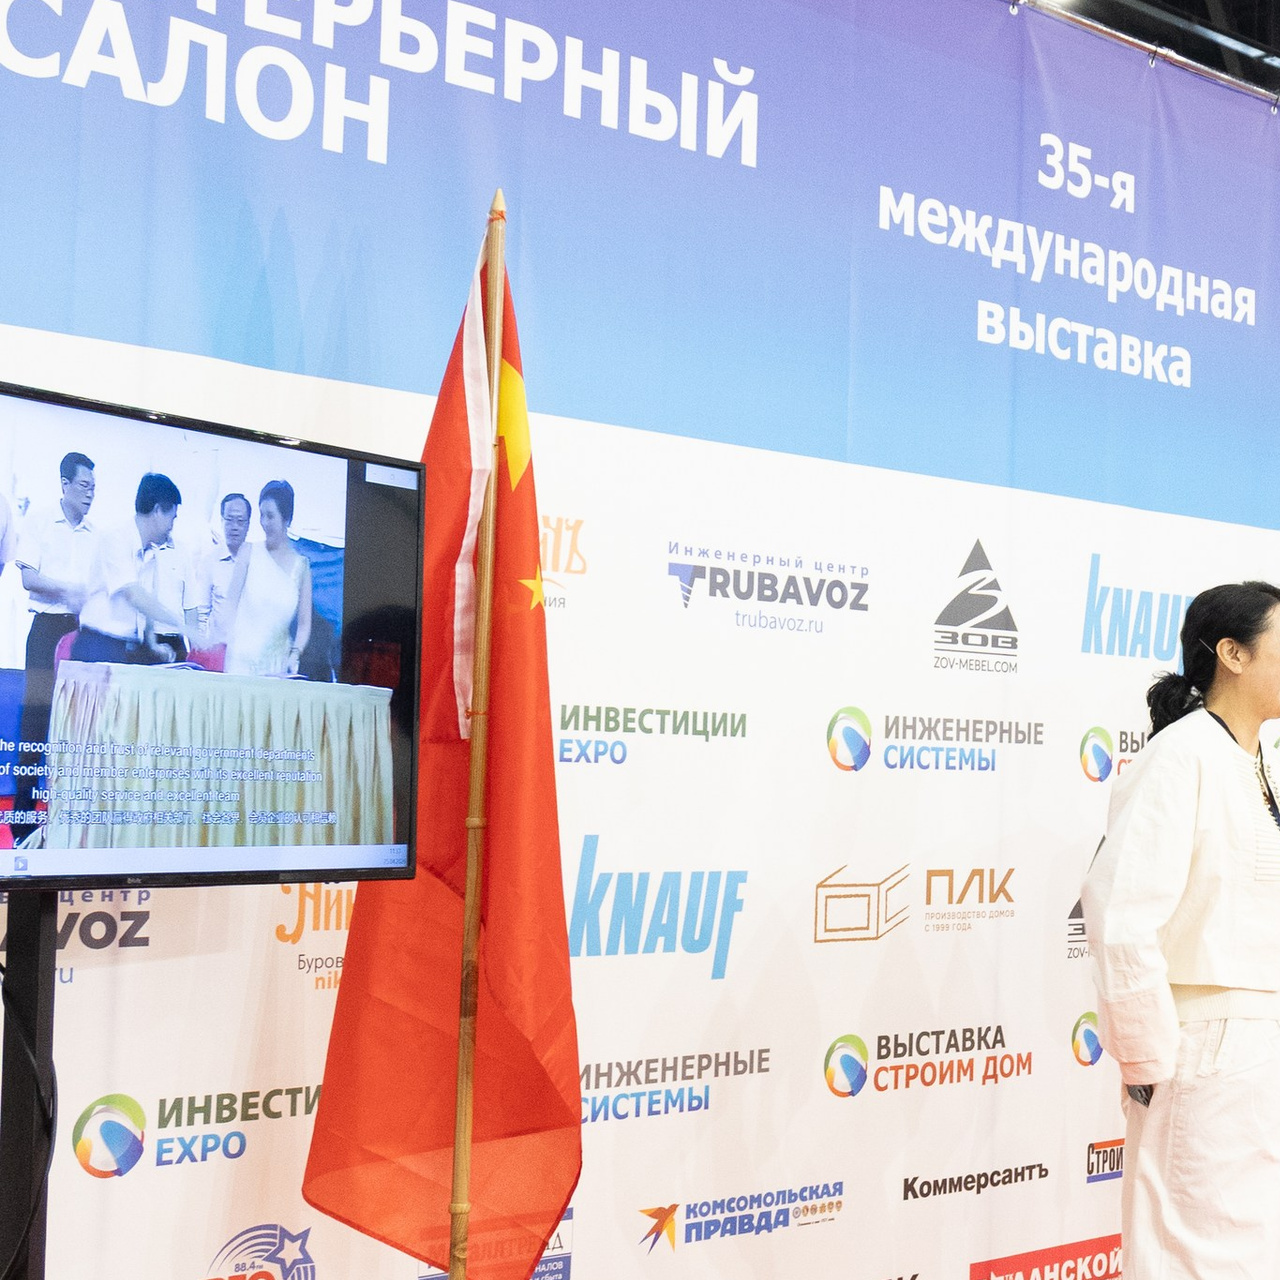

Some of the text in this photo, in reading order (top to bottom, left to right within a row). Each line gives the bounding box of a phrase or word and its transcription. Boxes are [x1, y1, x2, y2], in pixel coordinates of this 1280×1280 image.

[1037, 133, 1136, 213] 35-я
[879, 185, 1256, 326] международная
[977, 299, 1191, 388] выставка
[668, 541, 869, 578] Инженерный центр
[668, 562, 869, 611] TRUBAVOZ
[735, 610, 824, 634] trubavoz.ru
[934, 630, 1018, 650] ЗОВ
[933, 656, 1018, 673] ZOV-MEBEL.COM
[560, 704, 747, 742] ИНВЕСТИЦИИ
[884, 715, 1044, 745] ИНЖЕНЕРНЫЕ
[0, 739, 315, 761] he recognition and trust of relevant government departments
[559, 738, 627, 764] EXPO
[884, 744, 996, 772] СИСТЕМЫ
[13, 763, 55, 779] society
[58, 765, 82, 778] and
[83, 766, 129, 778] member
[132, 767, 190, 781] enterprises
[231, 769, 274, 781] excellent
[276, 771, 322, 784] reputation
[32, 787, 240, 802] high-quality service and excellent team
[60, 889, 150, 906] центр
[926, 868, 1015, 905] ПЛК
[925, 910, 1015, 921] ПРОИЗВОДСТВО ДОМОВ
[932, 924, 949, 932] 1999
[952, 923, 972, 931] ГОДА
[297, 954, 344, 974] Буров
[877, 1025, 1006, 1061] ВЫСТАВКА
[873, 1052, 1032, 1092] СТРОИМ ДОМ
[156, 1131, 247, 1167] EXPO
[903, 1163, 1049, 1201] Коммерсантъ
[685, 1181, 844, 1219] КОМСОМОЛЬСКАЯ
[685, 1208, 789, 1243] ПРАВДА
[234, 1261, 255, 1272] 88.4
